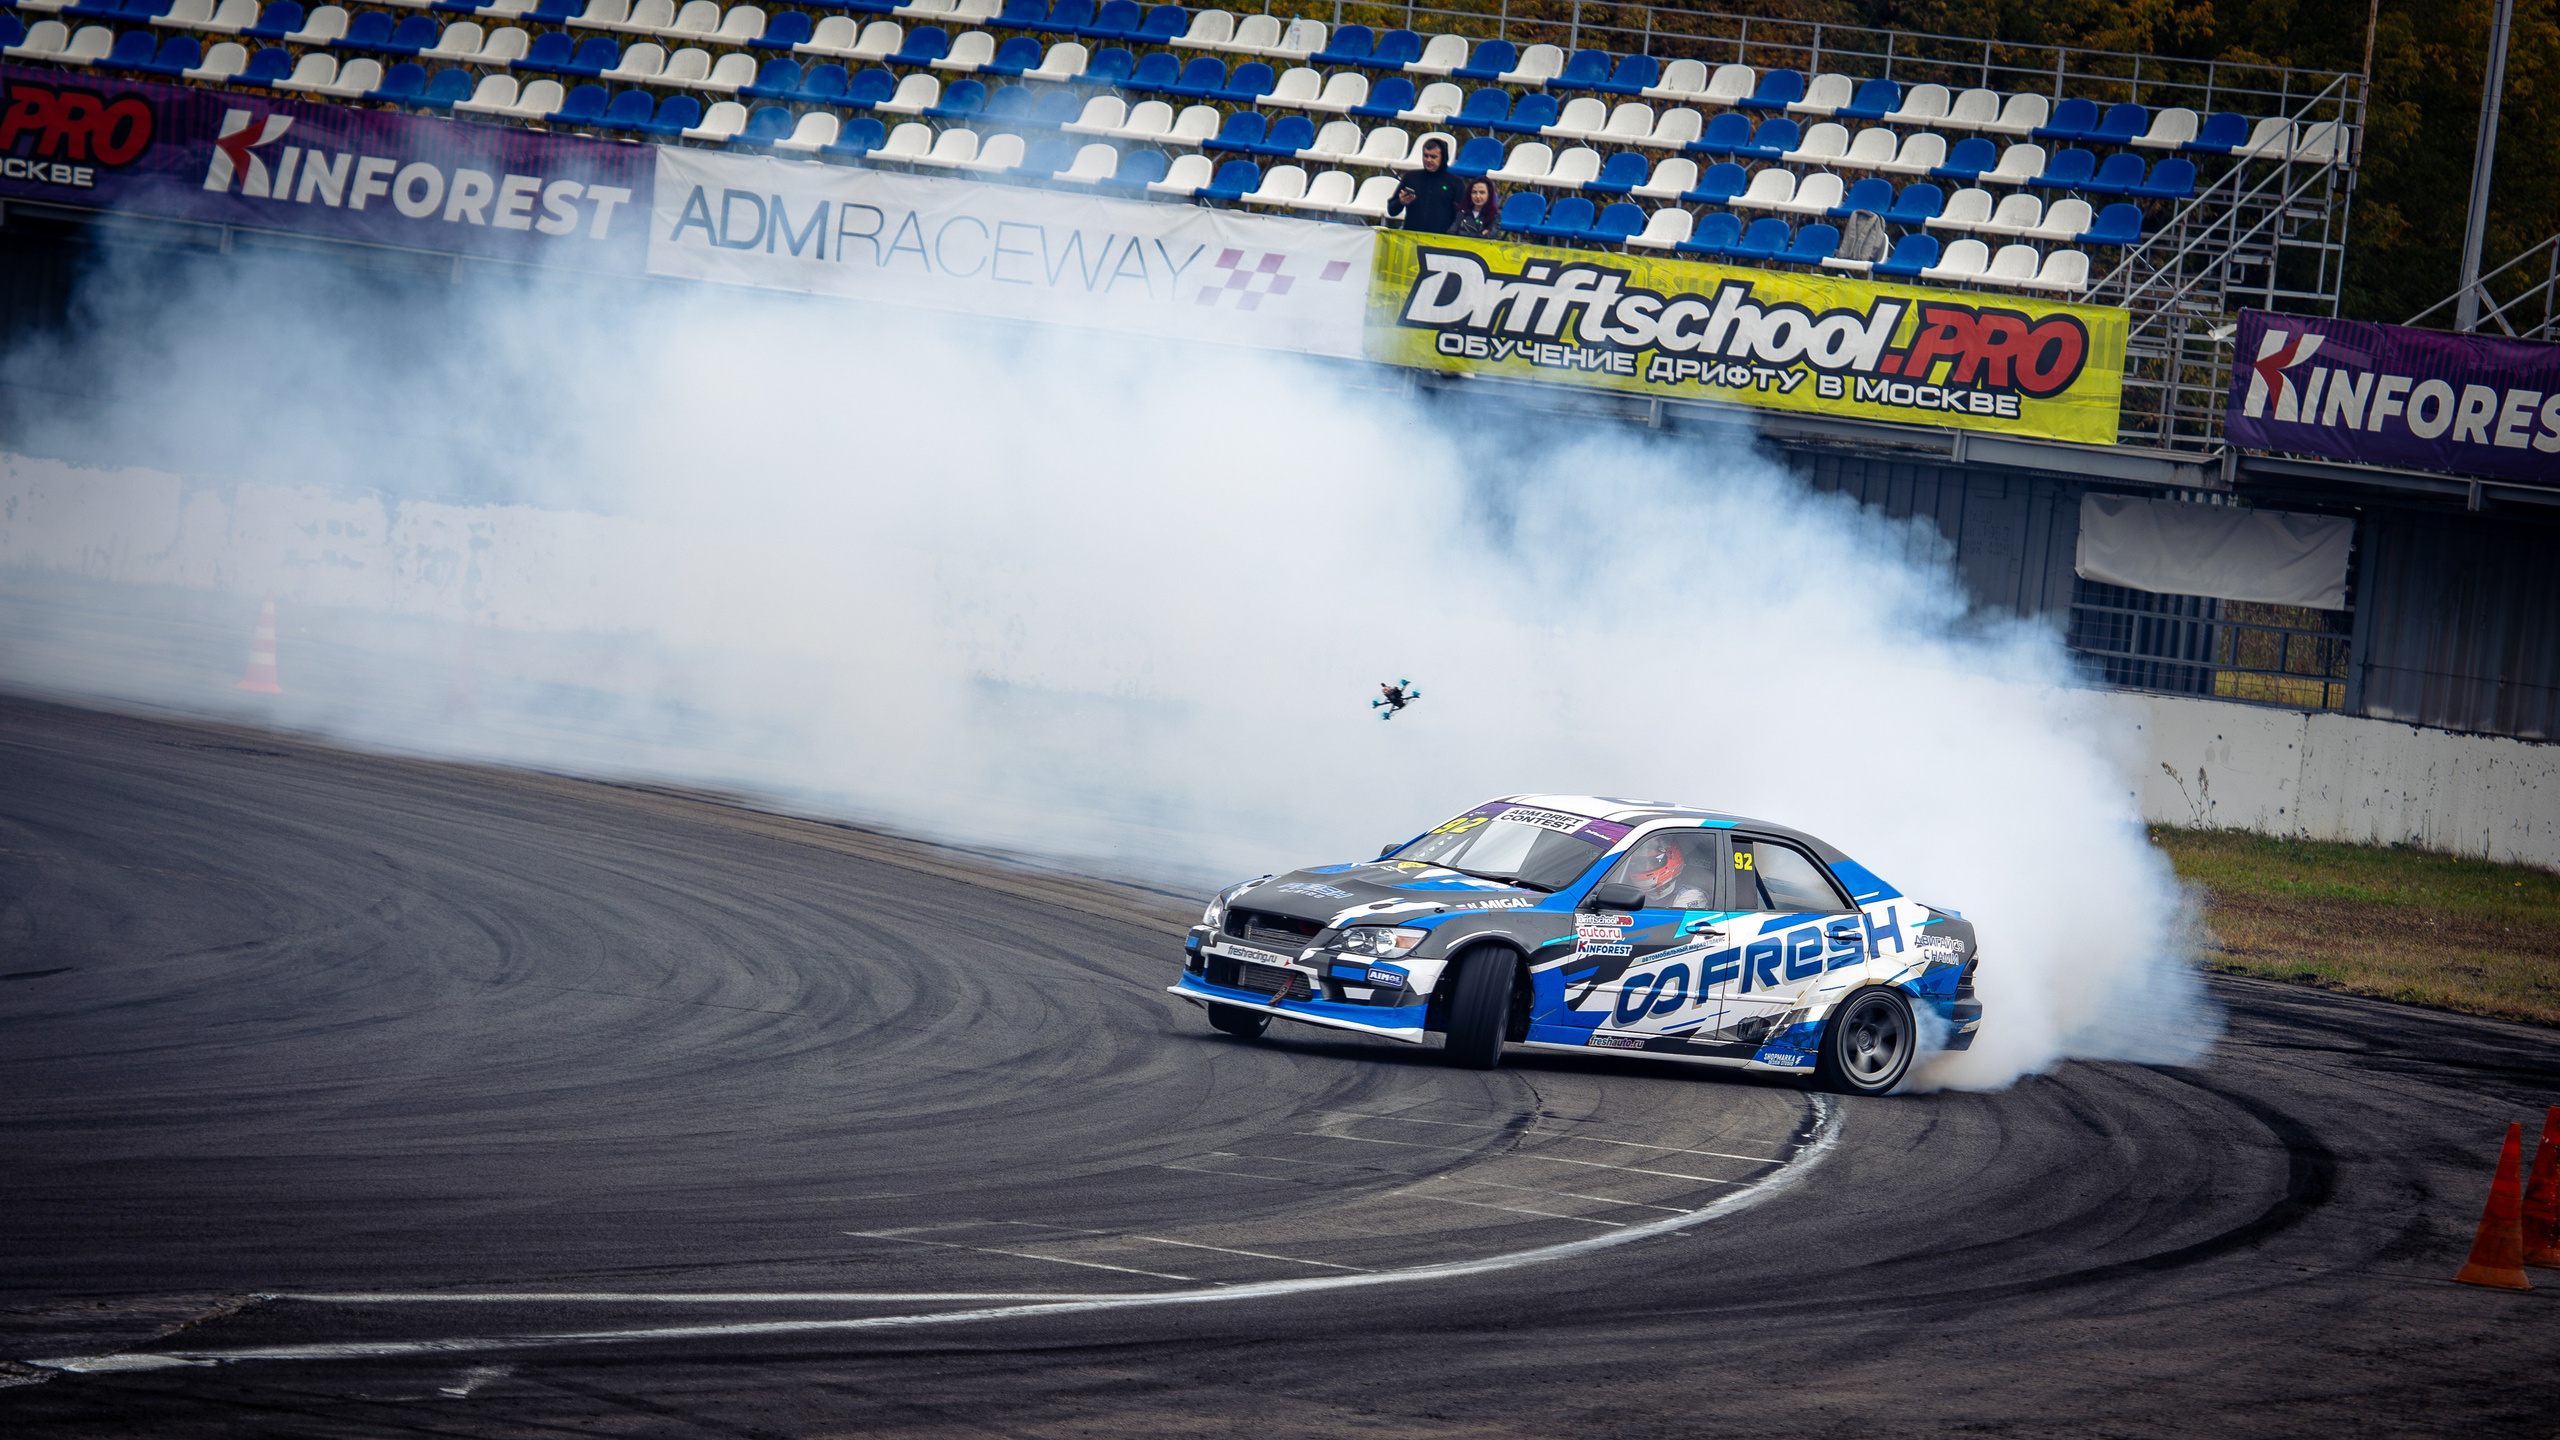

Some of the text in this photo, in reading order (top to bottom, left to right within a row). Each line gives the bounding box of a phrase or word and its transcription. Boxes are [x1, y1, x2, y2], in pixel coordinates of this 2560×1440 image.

[0, 85, 152, 165] PRO
[0, 157, 94, 188] СКВЕ
[203, 108, 631, 240] KINFOREST
[1406, 252, 2082, 392] Driftschool.PRO
[1438, 332, 2018, 417] ОБУЧЕНИЕ ДРИФТУ В МОСКВЕ
[1431, 817, 1489, 835] 92
[1500, 814, 1576, 830] CONTEST
[1509, 809, 1584, 825] ADM DRIFT
[1734, 852, 1753, 871] 92
[1579, 928, 1621, 939] auto.ru
[1227, 945, 1279, 964] freshracing.ru
[1577, 940, 1632, 955] KINFOREST
[1641, 945, 1689, 963] автомобильный
[1930, 949, 1960, 966] НАМИ
[1588, 1035, 1645, 1049] freshauto.ru
